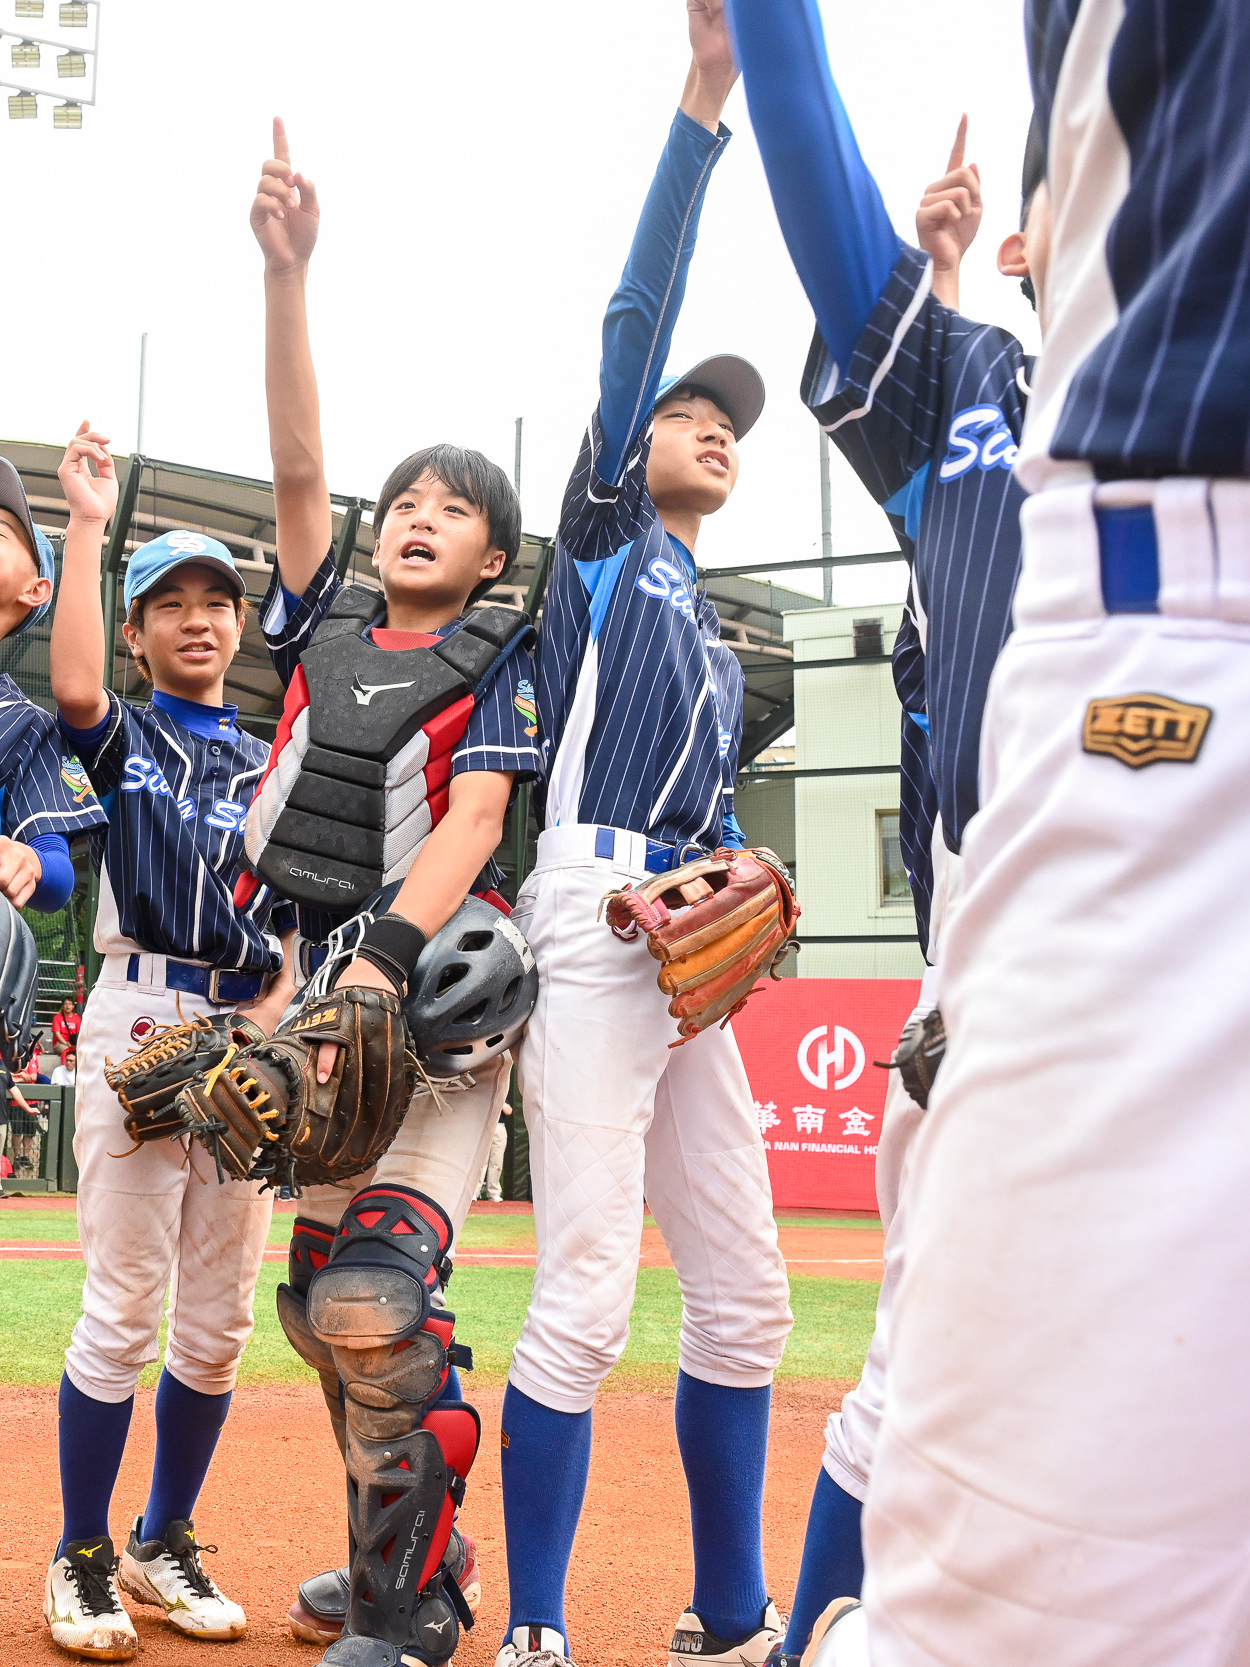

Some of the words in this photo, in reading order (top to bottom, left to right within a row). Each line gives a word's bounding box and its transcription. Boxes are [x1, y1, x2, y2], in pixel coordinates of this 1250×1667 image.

[1090, 706, 1199, 743] ZETT
[291, 1007, 338, 1032] ZETT
[773, 1141, 800, 1152] NAN
[801, 1142, 862, 1154] FINANCIAL
[395, 1510, 426, 1589] samurai
